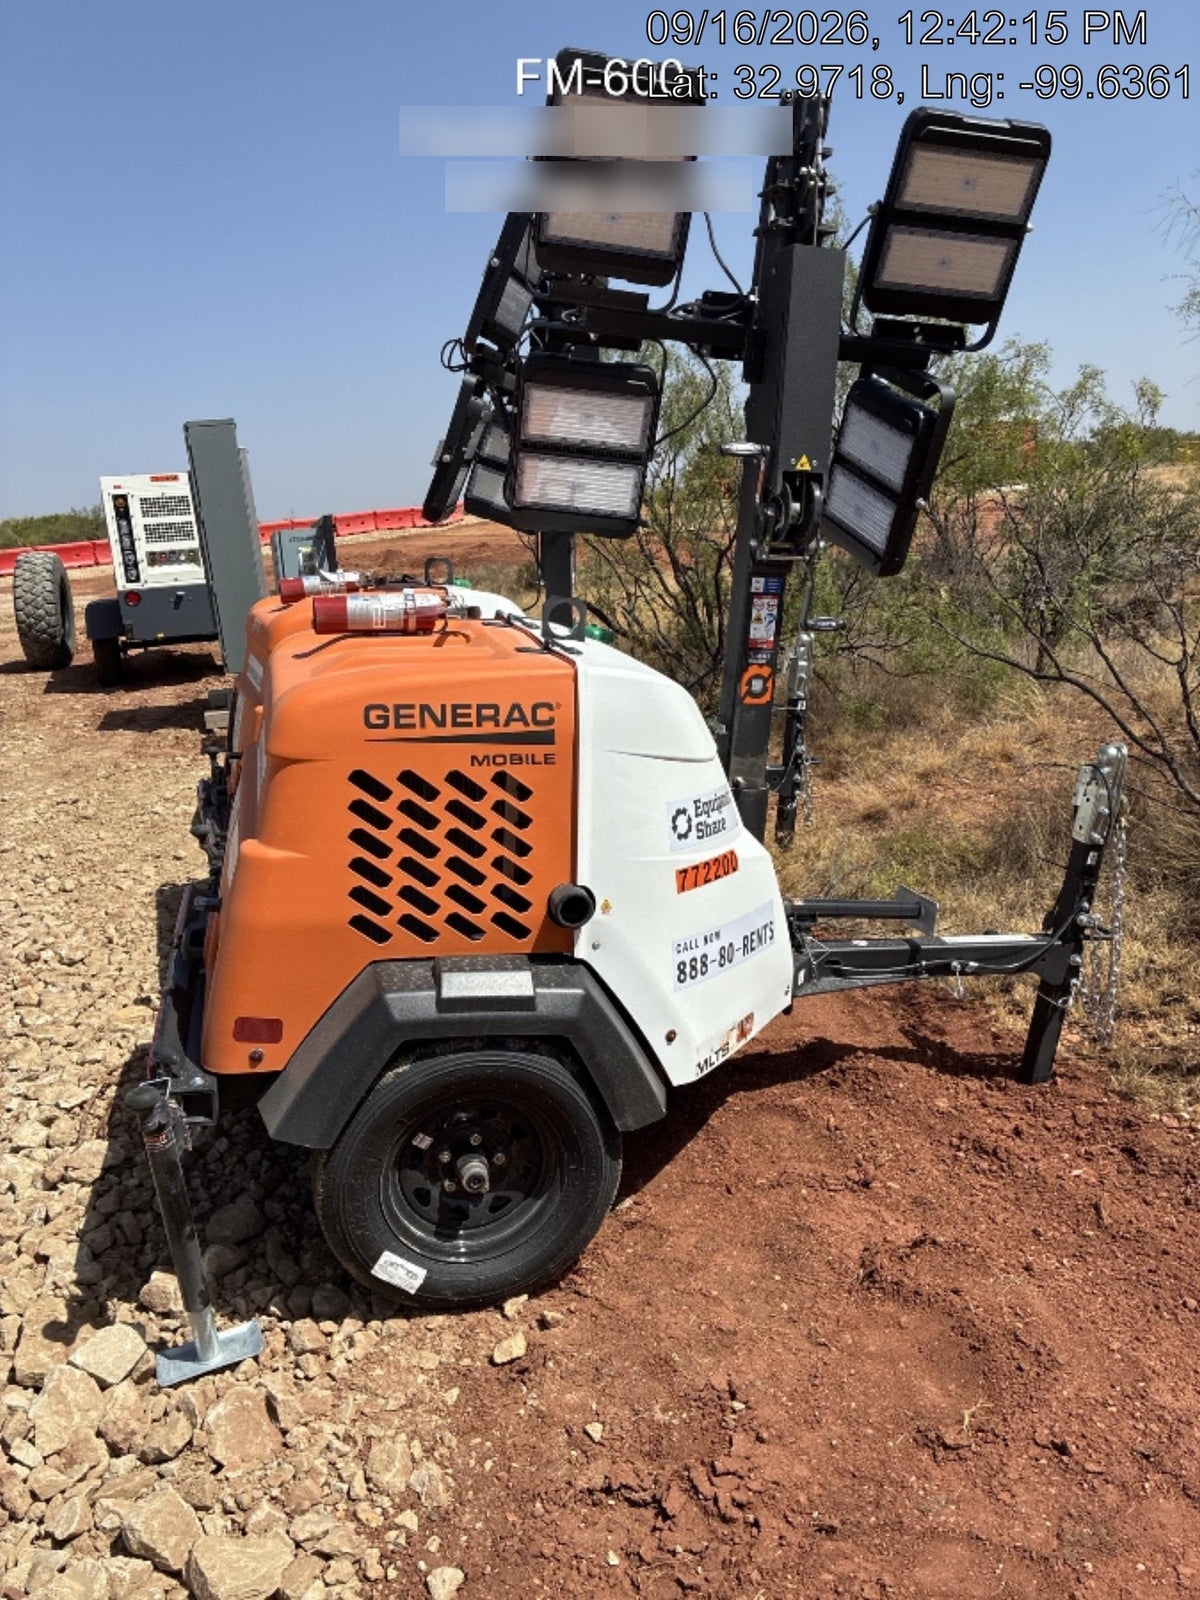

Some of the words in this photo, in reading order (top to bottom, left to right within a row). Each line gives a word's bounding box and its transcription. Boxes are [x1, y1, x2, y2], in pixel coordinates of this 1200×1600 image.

[364, 702, 555, 729] GENERAC
[470, 753, 556, 767] MOBILE
[696, 817, 726, 840] Share
[679, 853, 738, 892] 772200
[677, 920, 774, 984] 888-80-RENTS
